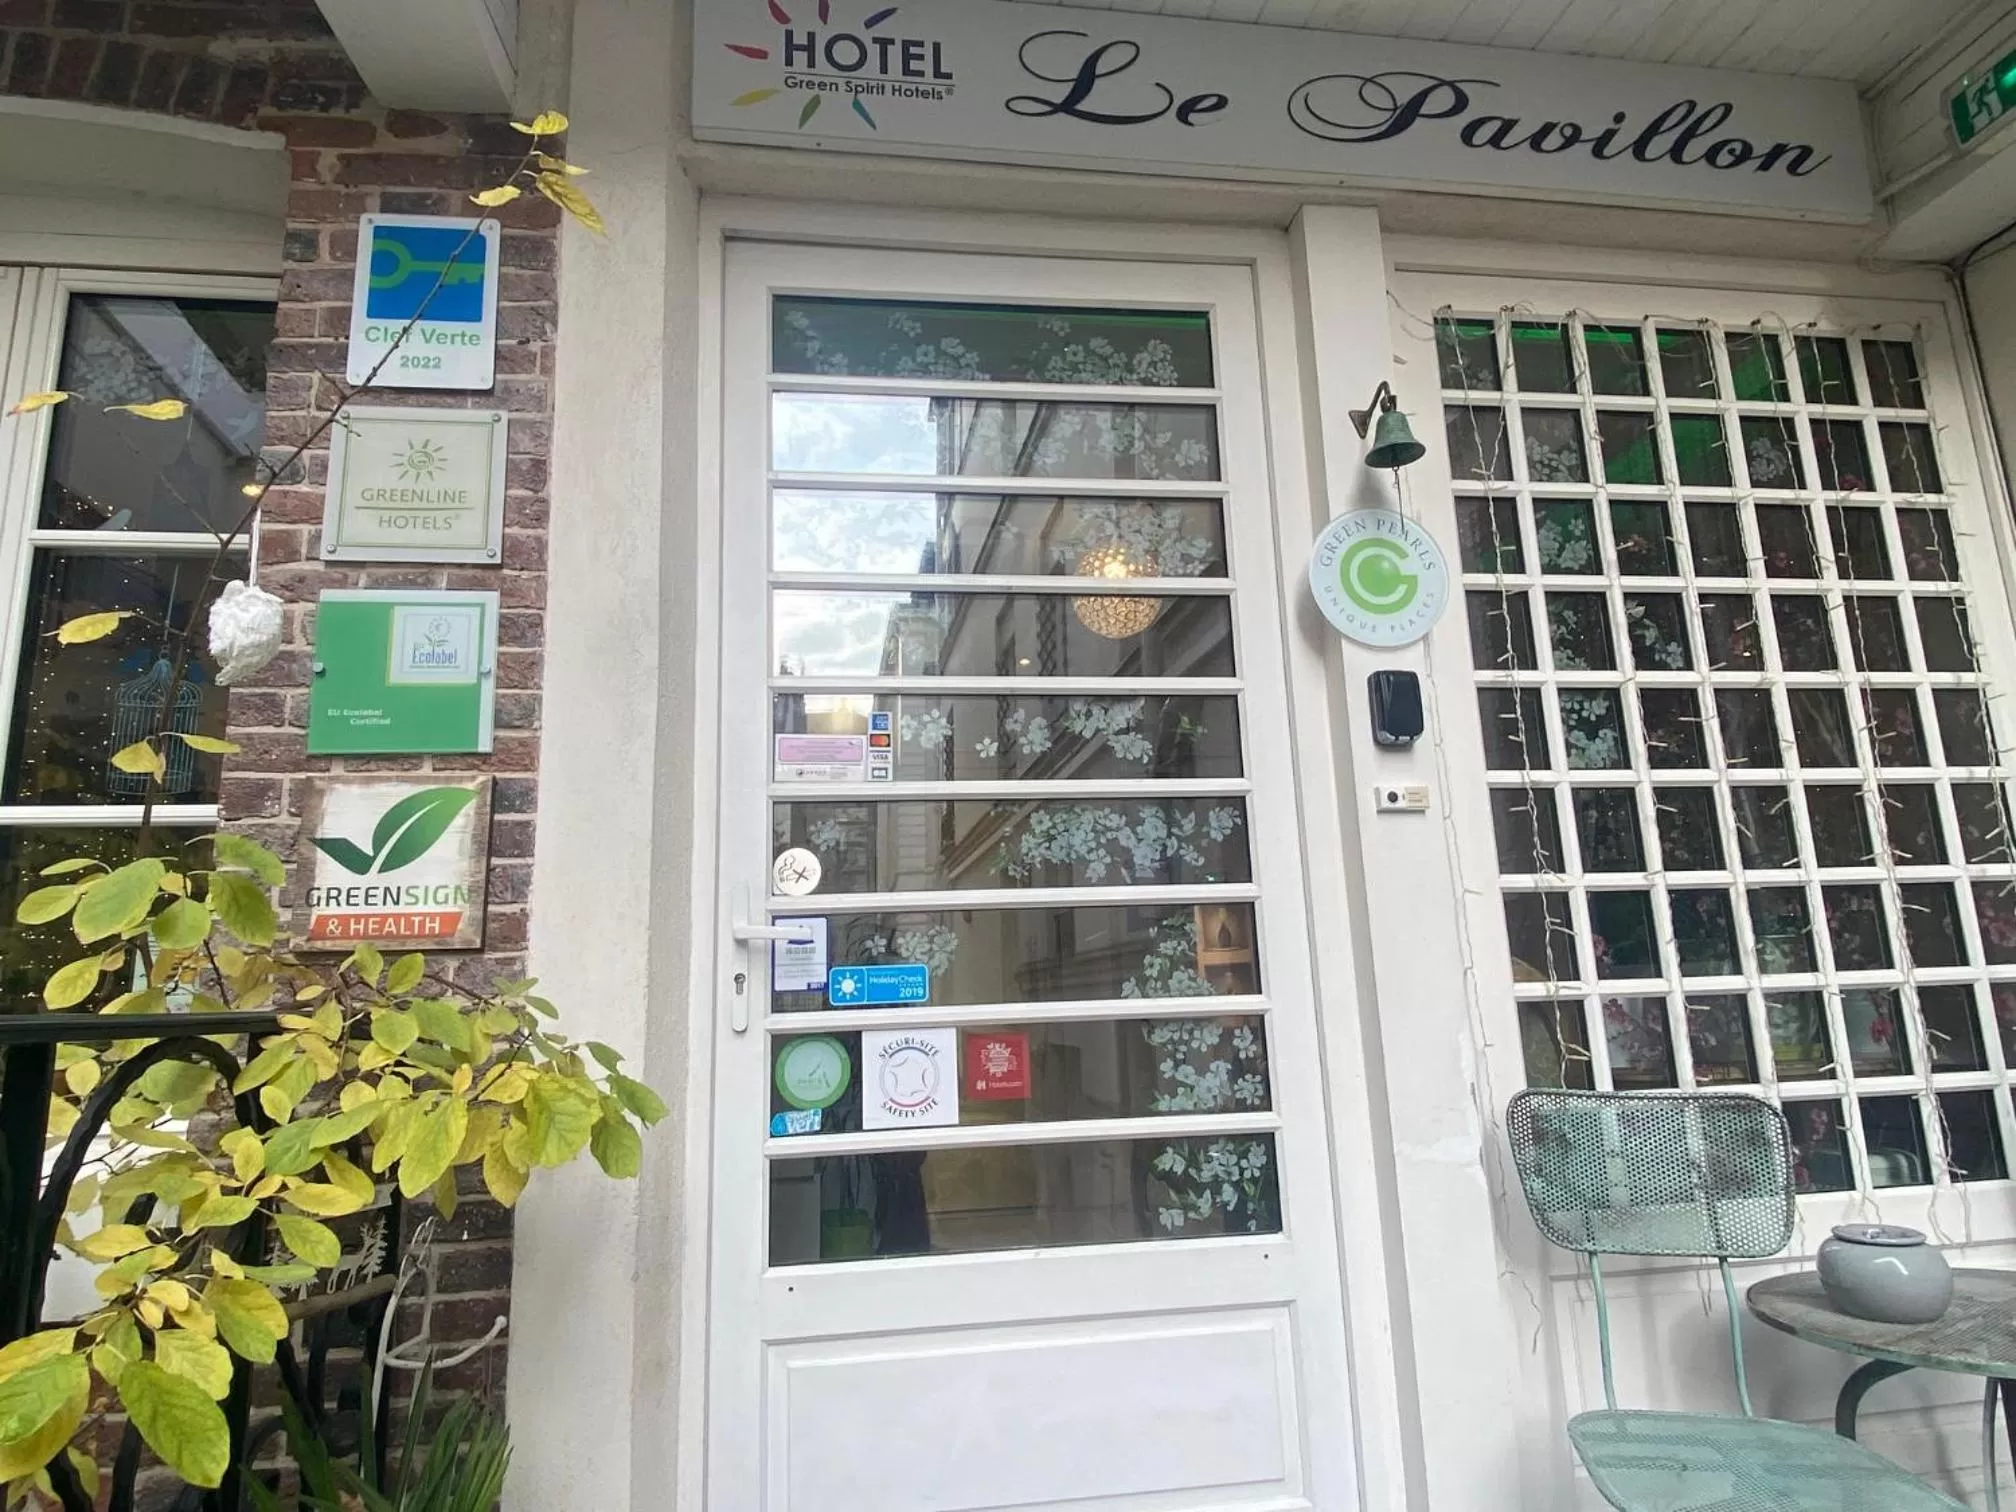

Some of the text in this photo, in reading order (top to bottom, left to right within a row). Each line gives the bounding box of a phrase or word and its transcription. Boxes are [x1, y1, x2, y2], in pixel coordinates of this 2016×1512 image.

[784, 29, 954, 80] HOTEL
[784, 76, 839, 92] Green
[844, 81, 886, 100] Spirit
[1004, 31, 1833, 177] Le Pavillon
[420, 328, 481, 346] Verte
[400, 355, 442, 369] 2022
[361, 488, 468, 504] GREENLINE
[1320, 518, 1436, 571] GREEN PEARLS
[1324, 585, 1377, 632] UNIQUE
[412, 648, 457, 665] Ecolabel
[305, 885, 470, 908] GREENSIGN
[326, 916, 441, 937] & HEALTH
[869, 974, 923, 985] HolidayCheck
[899, 987, 924, 998] 2019
[880, 1098, 939, 1118] SAFETY SITE
